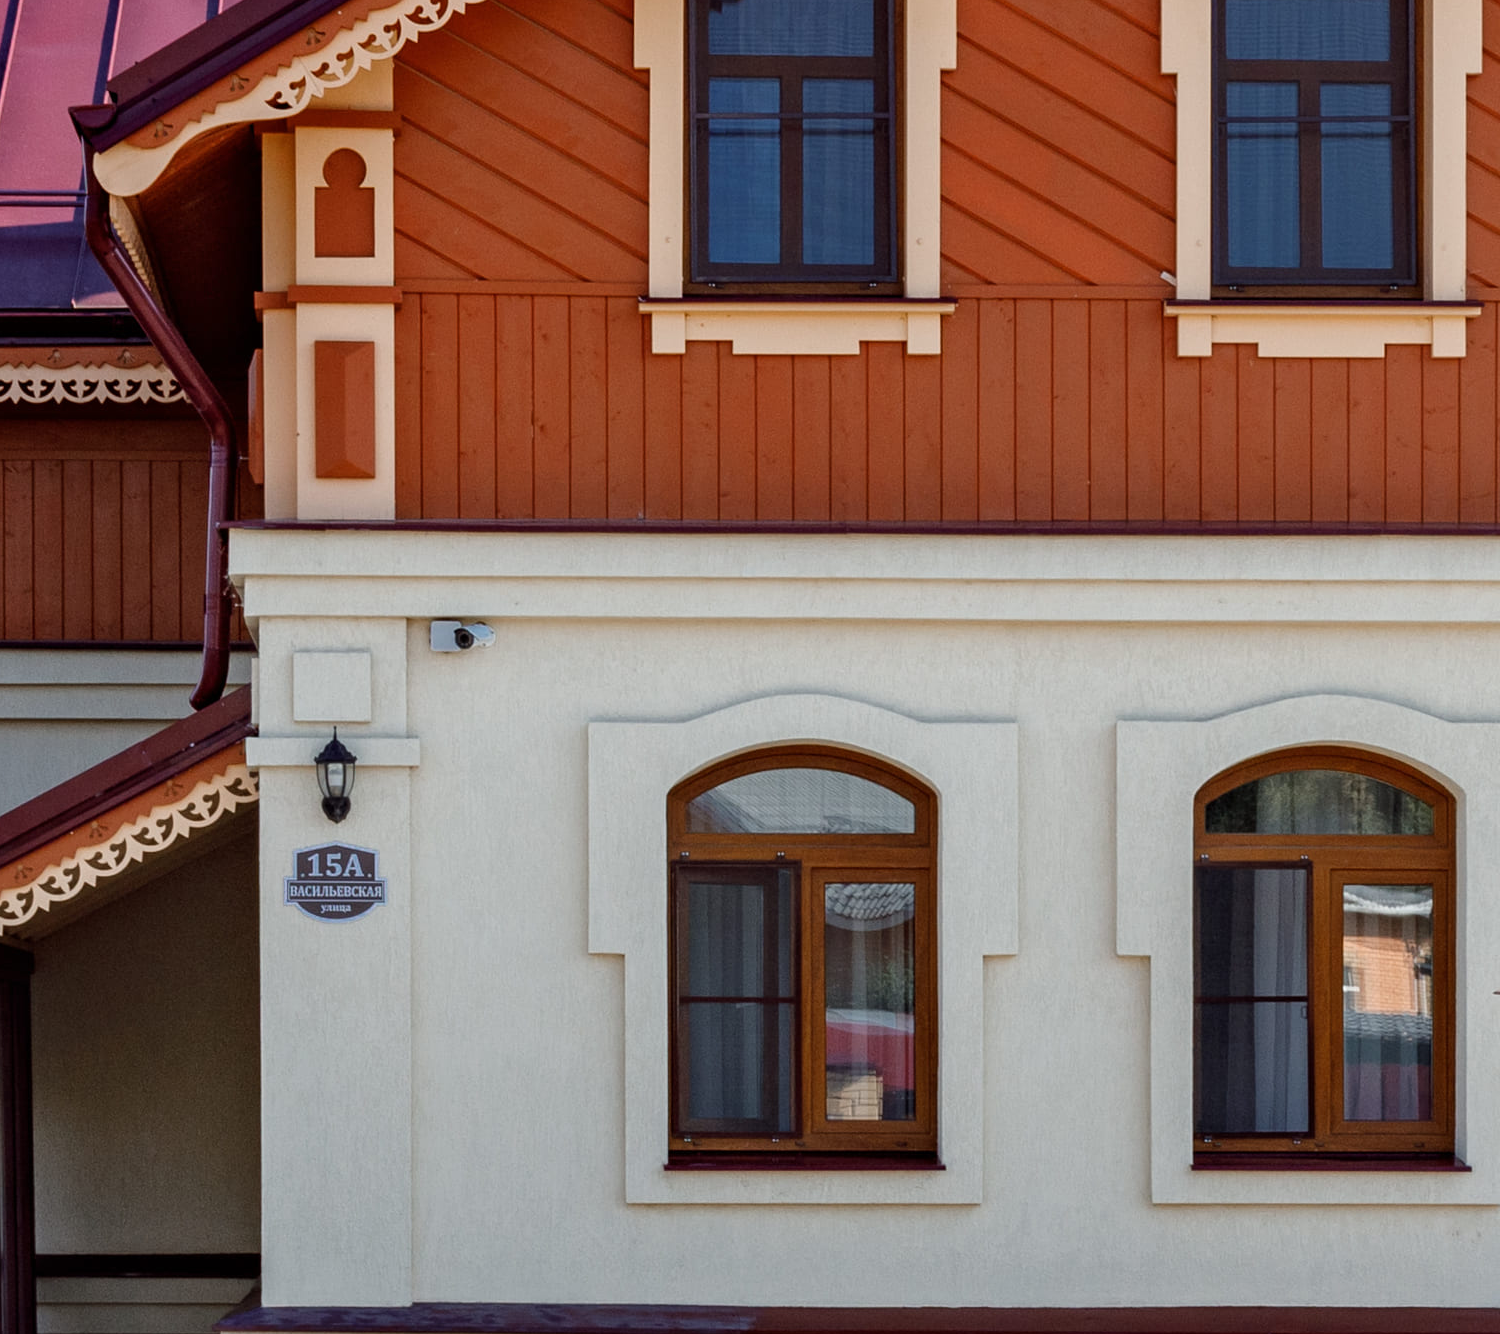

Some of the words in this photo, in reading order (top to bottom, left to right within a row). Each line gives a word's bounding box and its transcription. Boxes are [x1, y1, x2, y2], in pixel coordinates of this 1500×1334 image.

[307, 853, 365, 877] 15А
[290, 885, 382, 898] ВАСИЛЬЕВСКАЯ
[321, 904, 352, 914] улица
